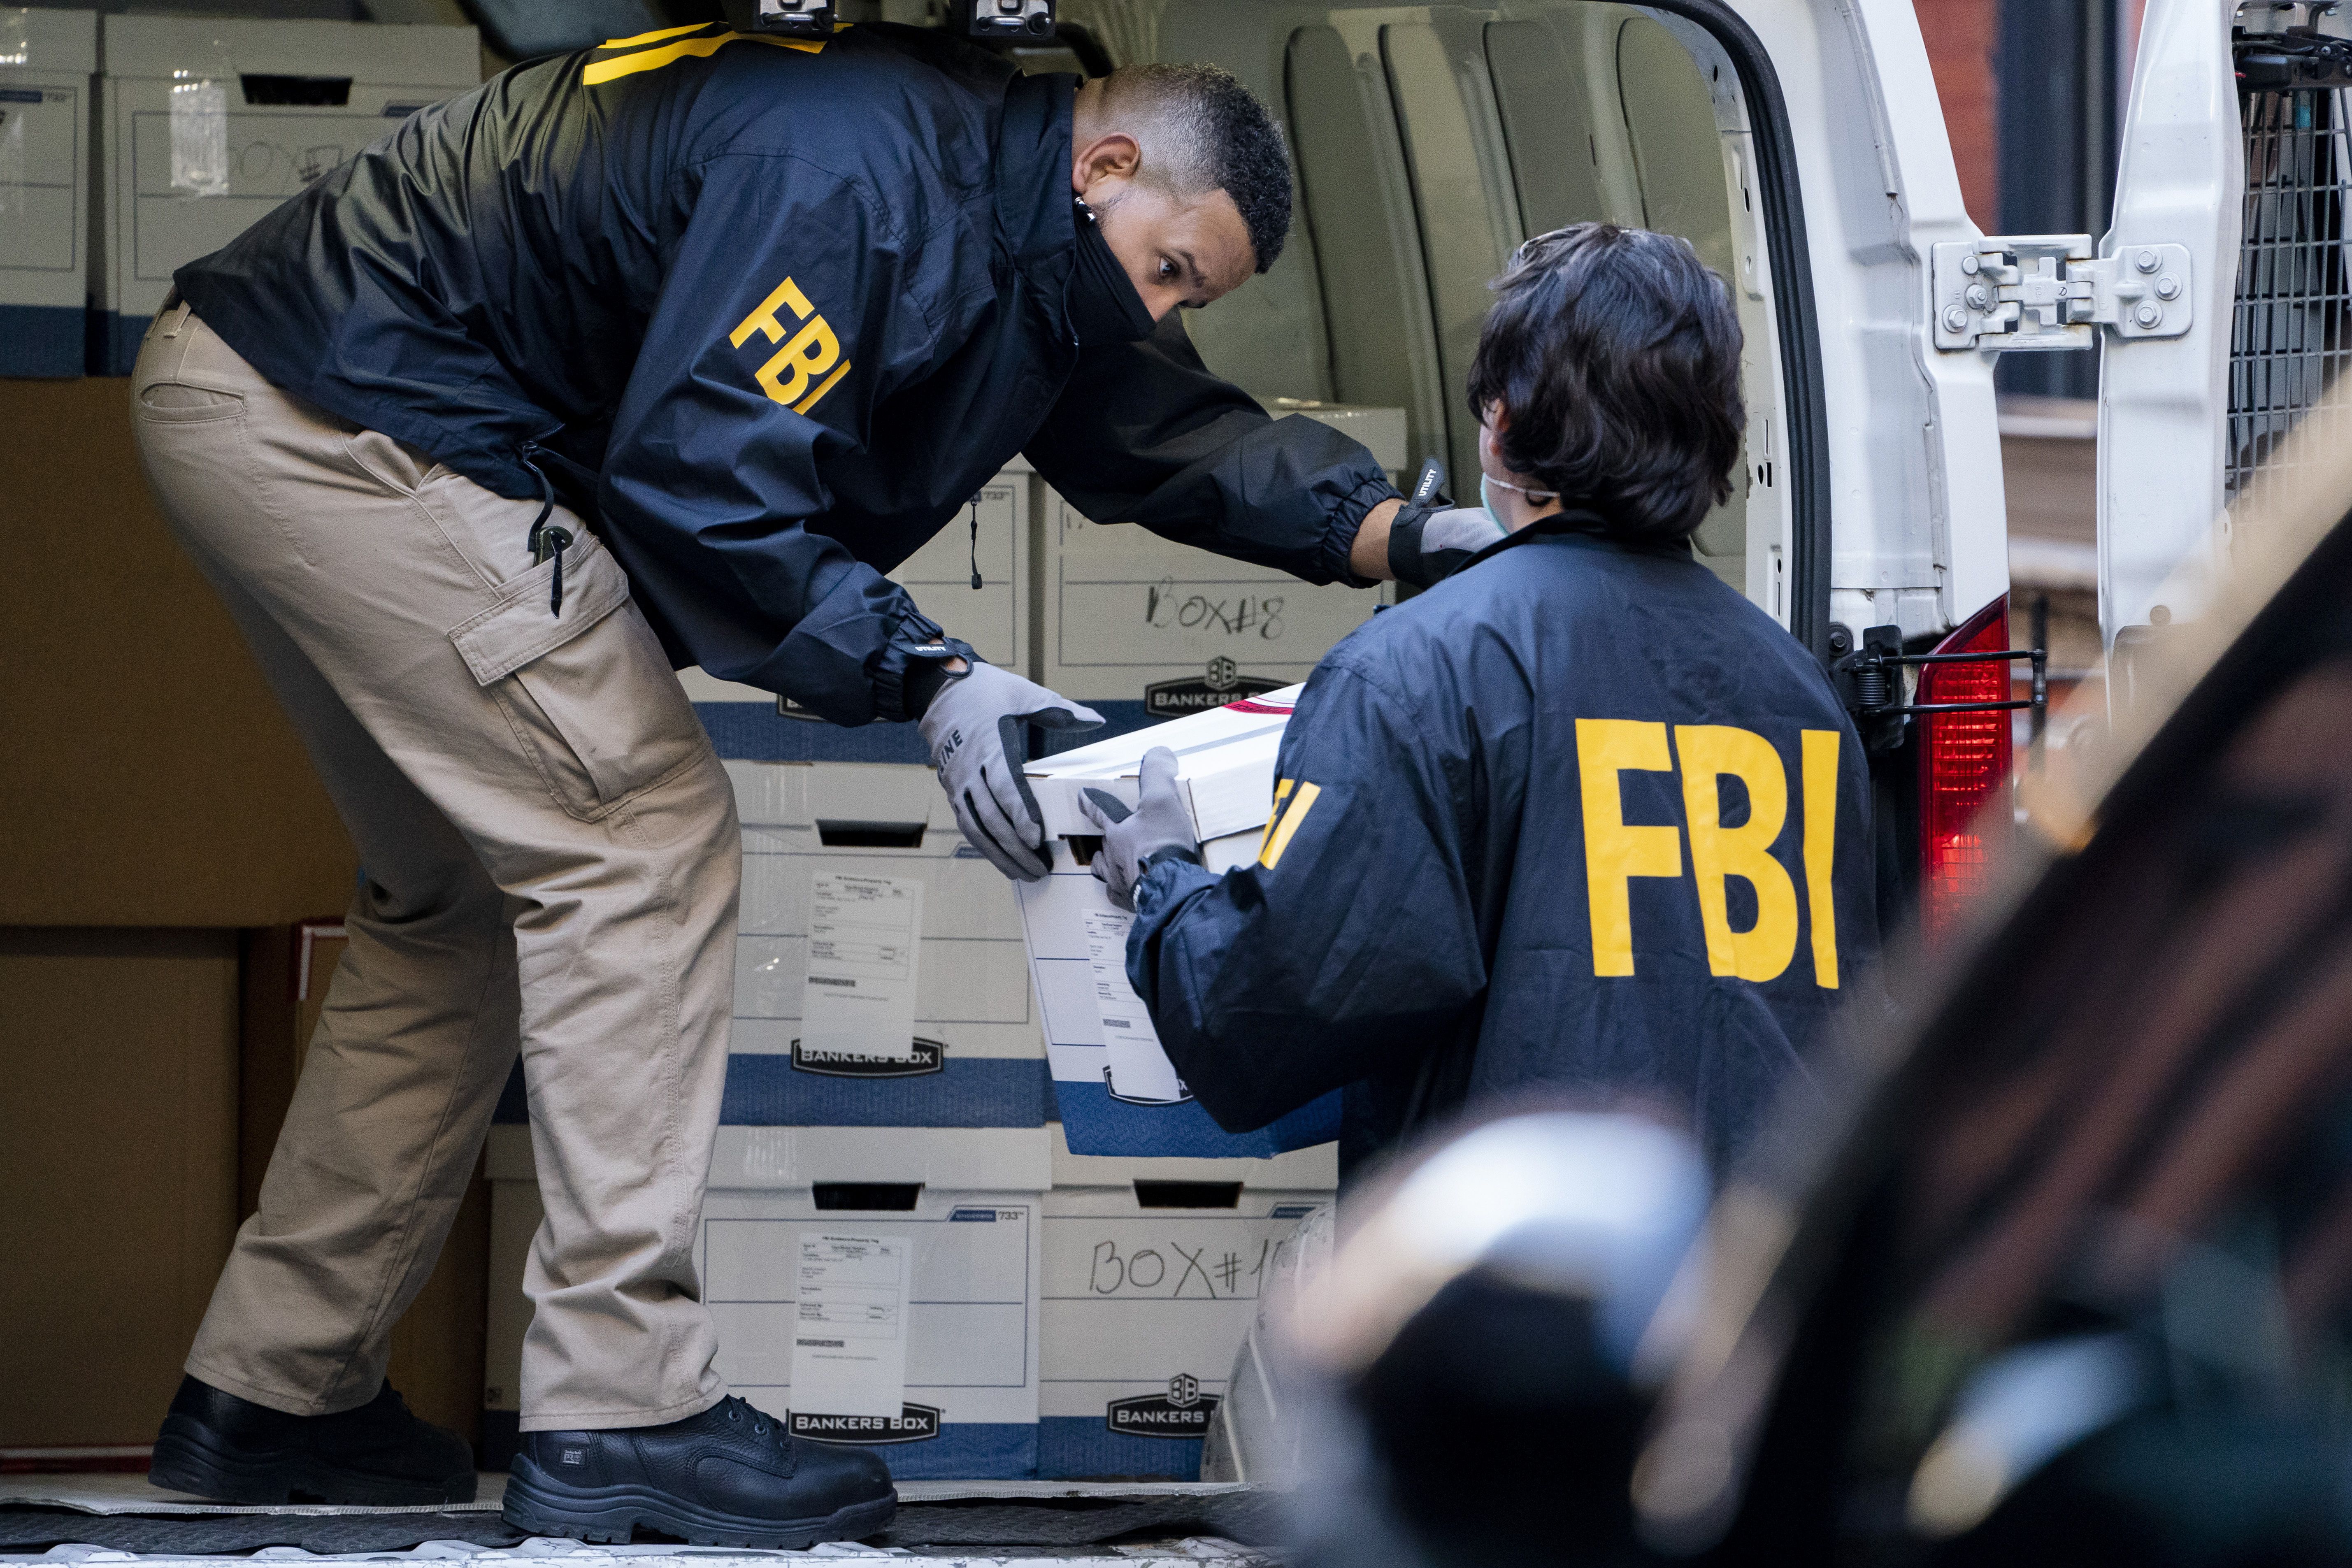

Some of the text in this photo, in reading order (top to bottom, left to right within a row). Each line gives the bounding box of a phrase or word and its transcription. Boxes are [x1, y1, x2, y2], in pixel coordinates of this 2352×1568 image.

[729, 276, 851, 415] FBI
[1418, 469, 1437, 496] UTILITY
[1575, 718, 1840, 989] FBI
[795, 1416, 929, 1430] BANKERS BOX
[1117, 1410, 1205, 1423] BANKERS
